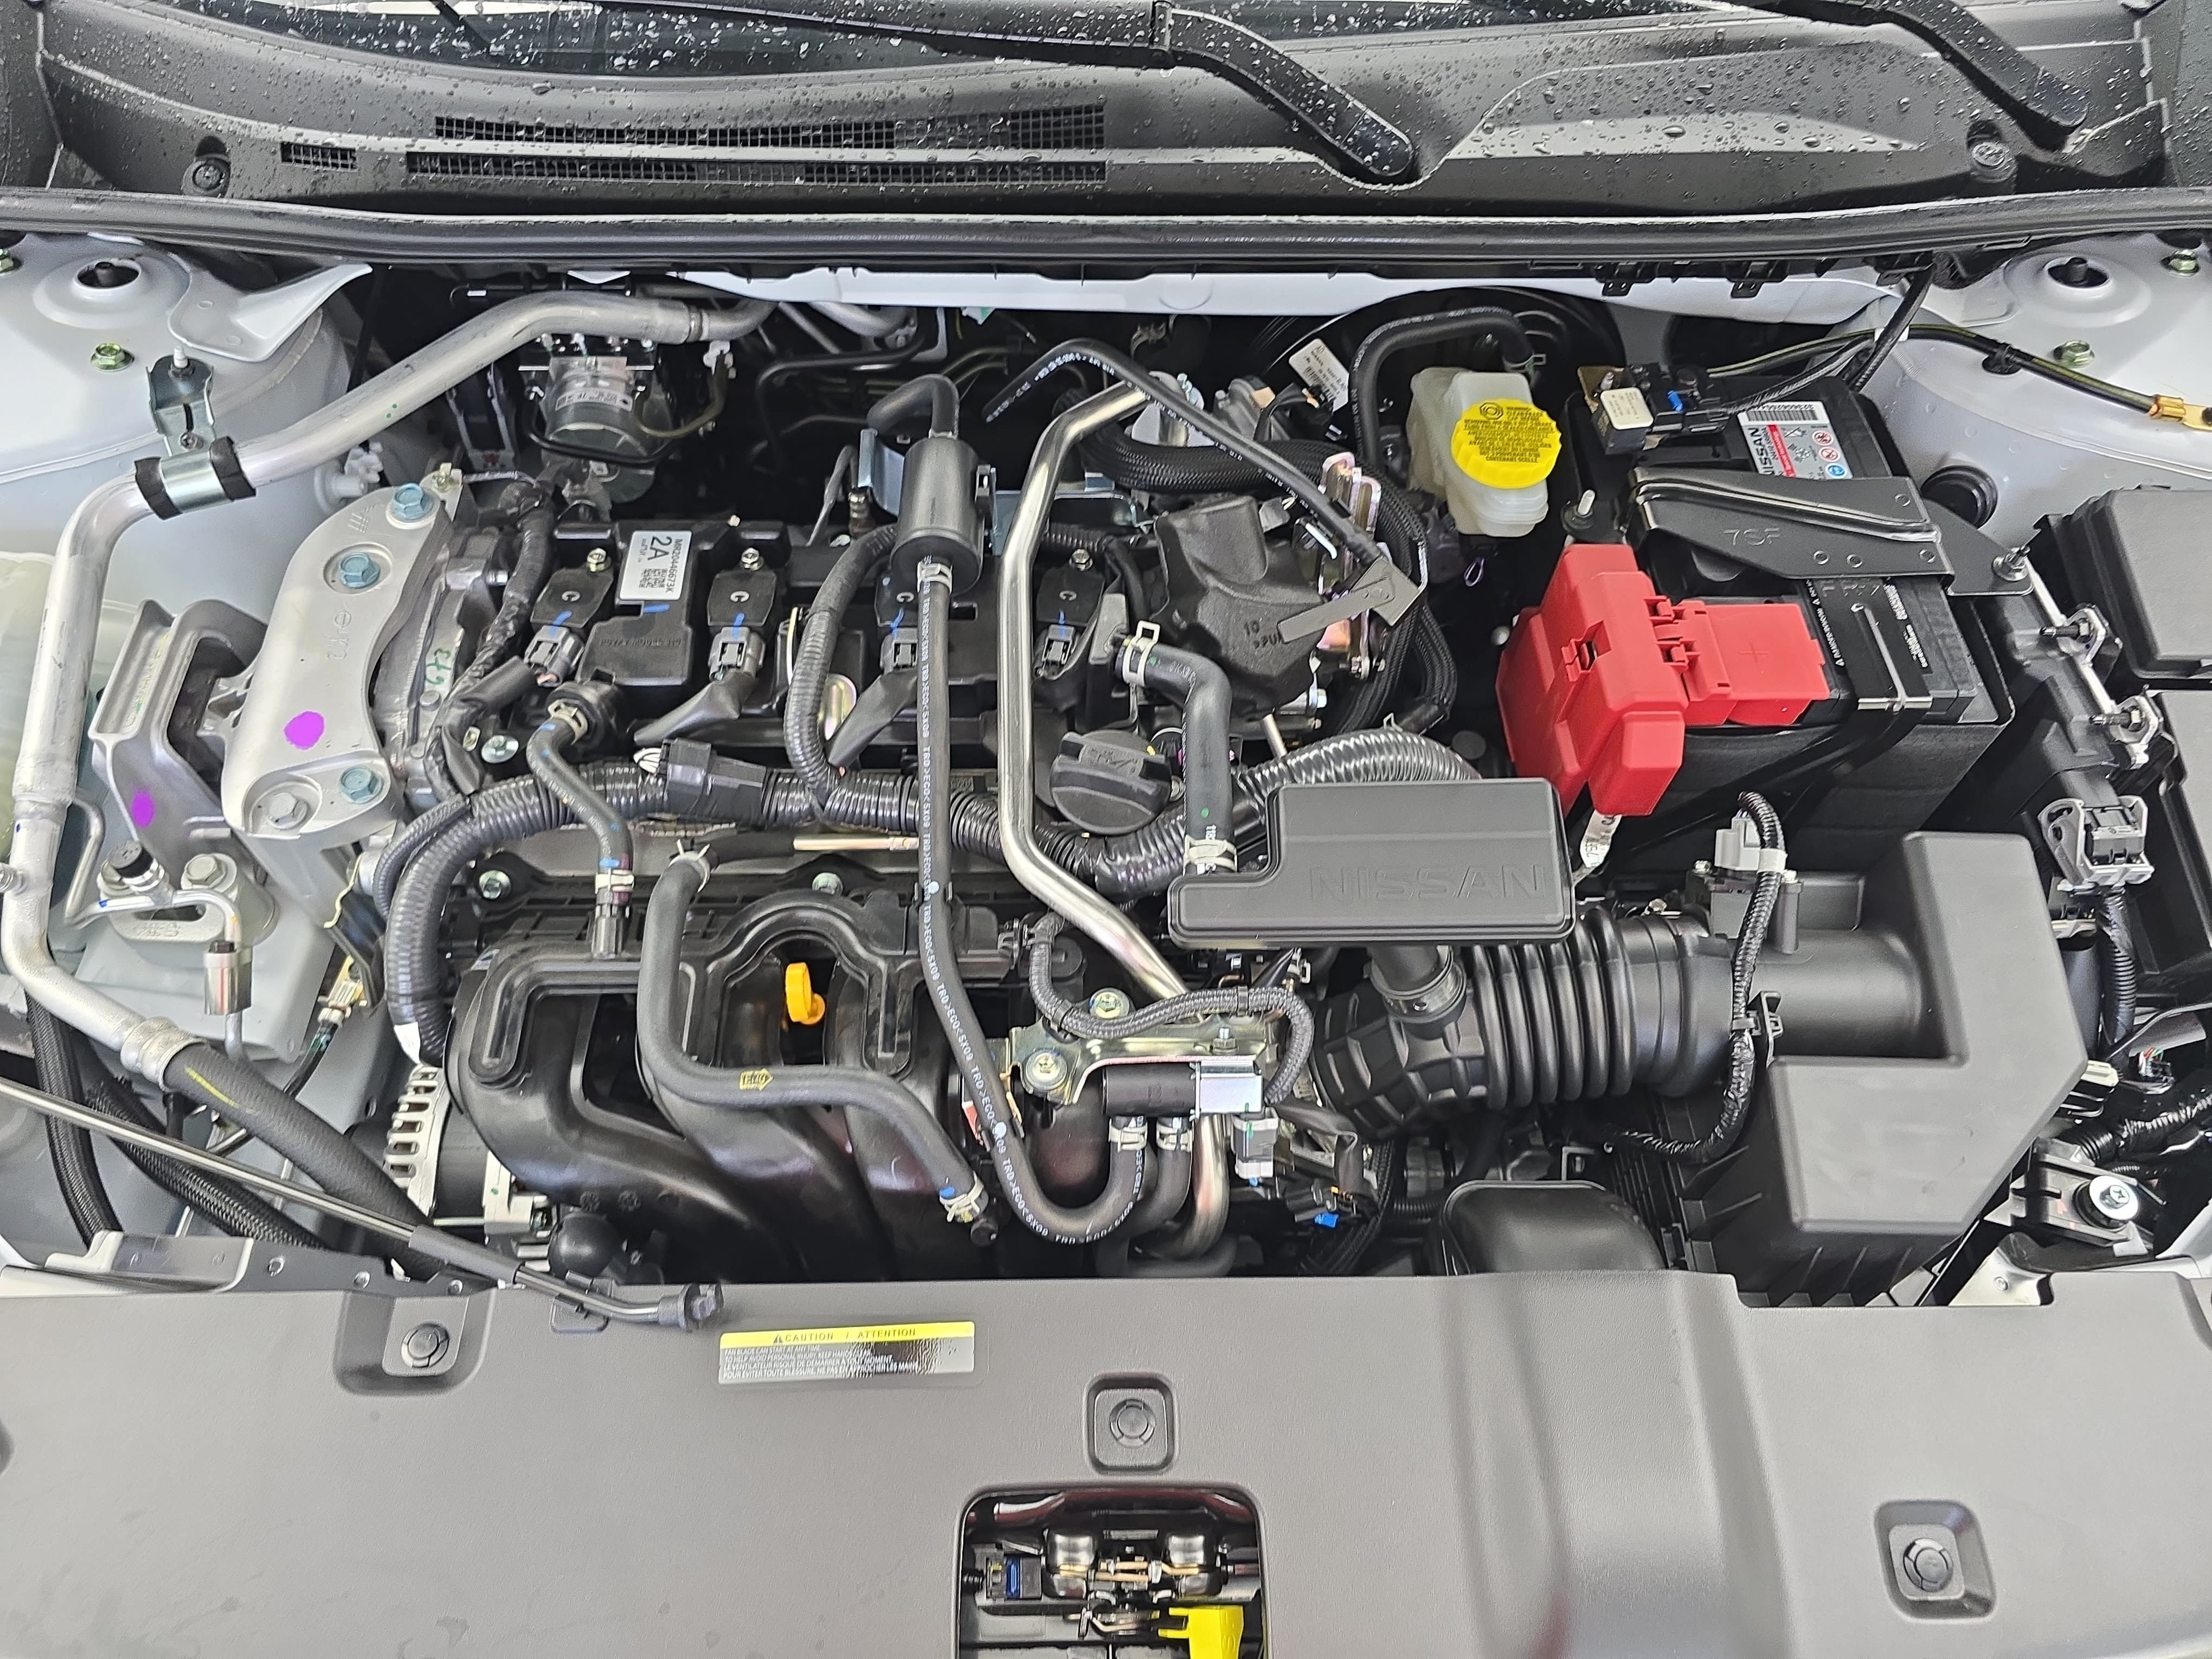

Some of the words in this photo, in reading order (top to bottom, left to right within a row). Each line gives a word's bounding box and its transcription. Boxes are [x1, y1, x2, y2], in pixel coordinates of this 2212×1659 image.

[1724, 528, 1781, 546] 7SF
[647, 536, 672, 561] 2A
[1308, 863, 1544, 902] NISSAN
[785, 1332, 833, 1342] CAUTION
[858, 1328, 916, 1339] ATTENTION
[794, 1345, 807, 1353] ANY
[732, 1361, 774, 1370] VENTILATEUR
[774, 1360, 796, 1369] RISQUE
[797, 1359, 806, 1367] DE
[748, 1354, 766, 1362] AVOID
[767, 1353, 796, 1361] PERSONAL
[723, 1370, 741, 1380] POUR
[763, 1368, 783, 1377] TOUTE
[817, 1367, 826, 1375] NE
[826, 1366, 838, 1375] PAS
